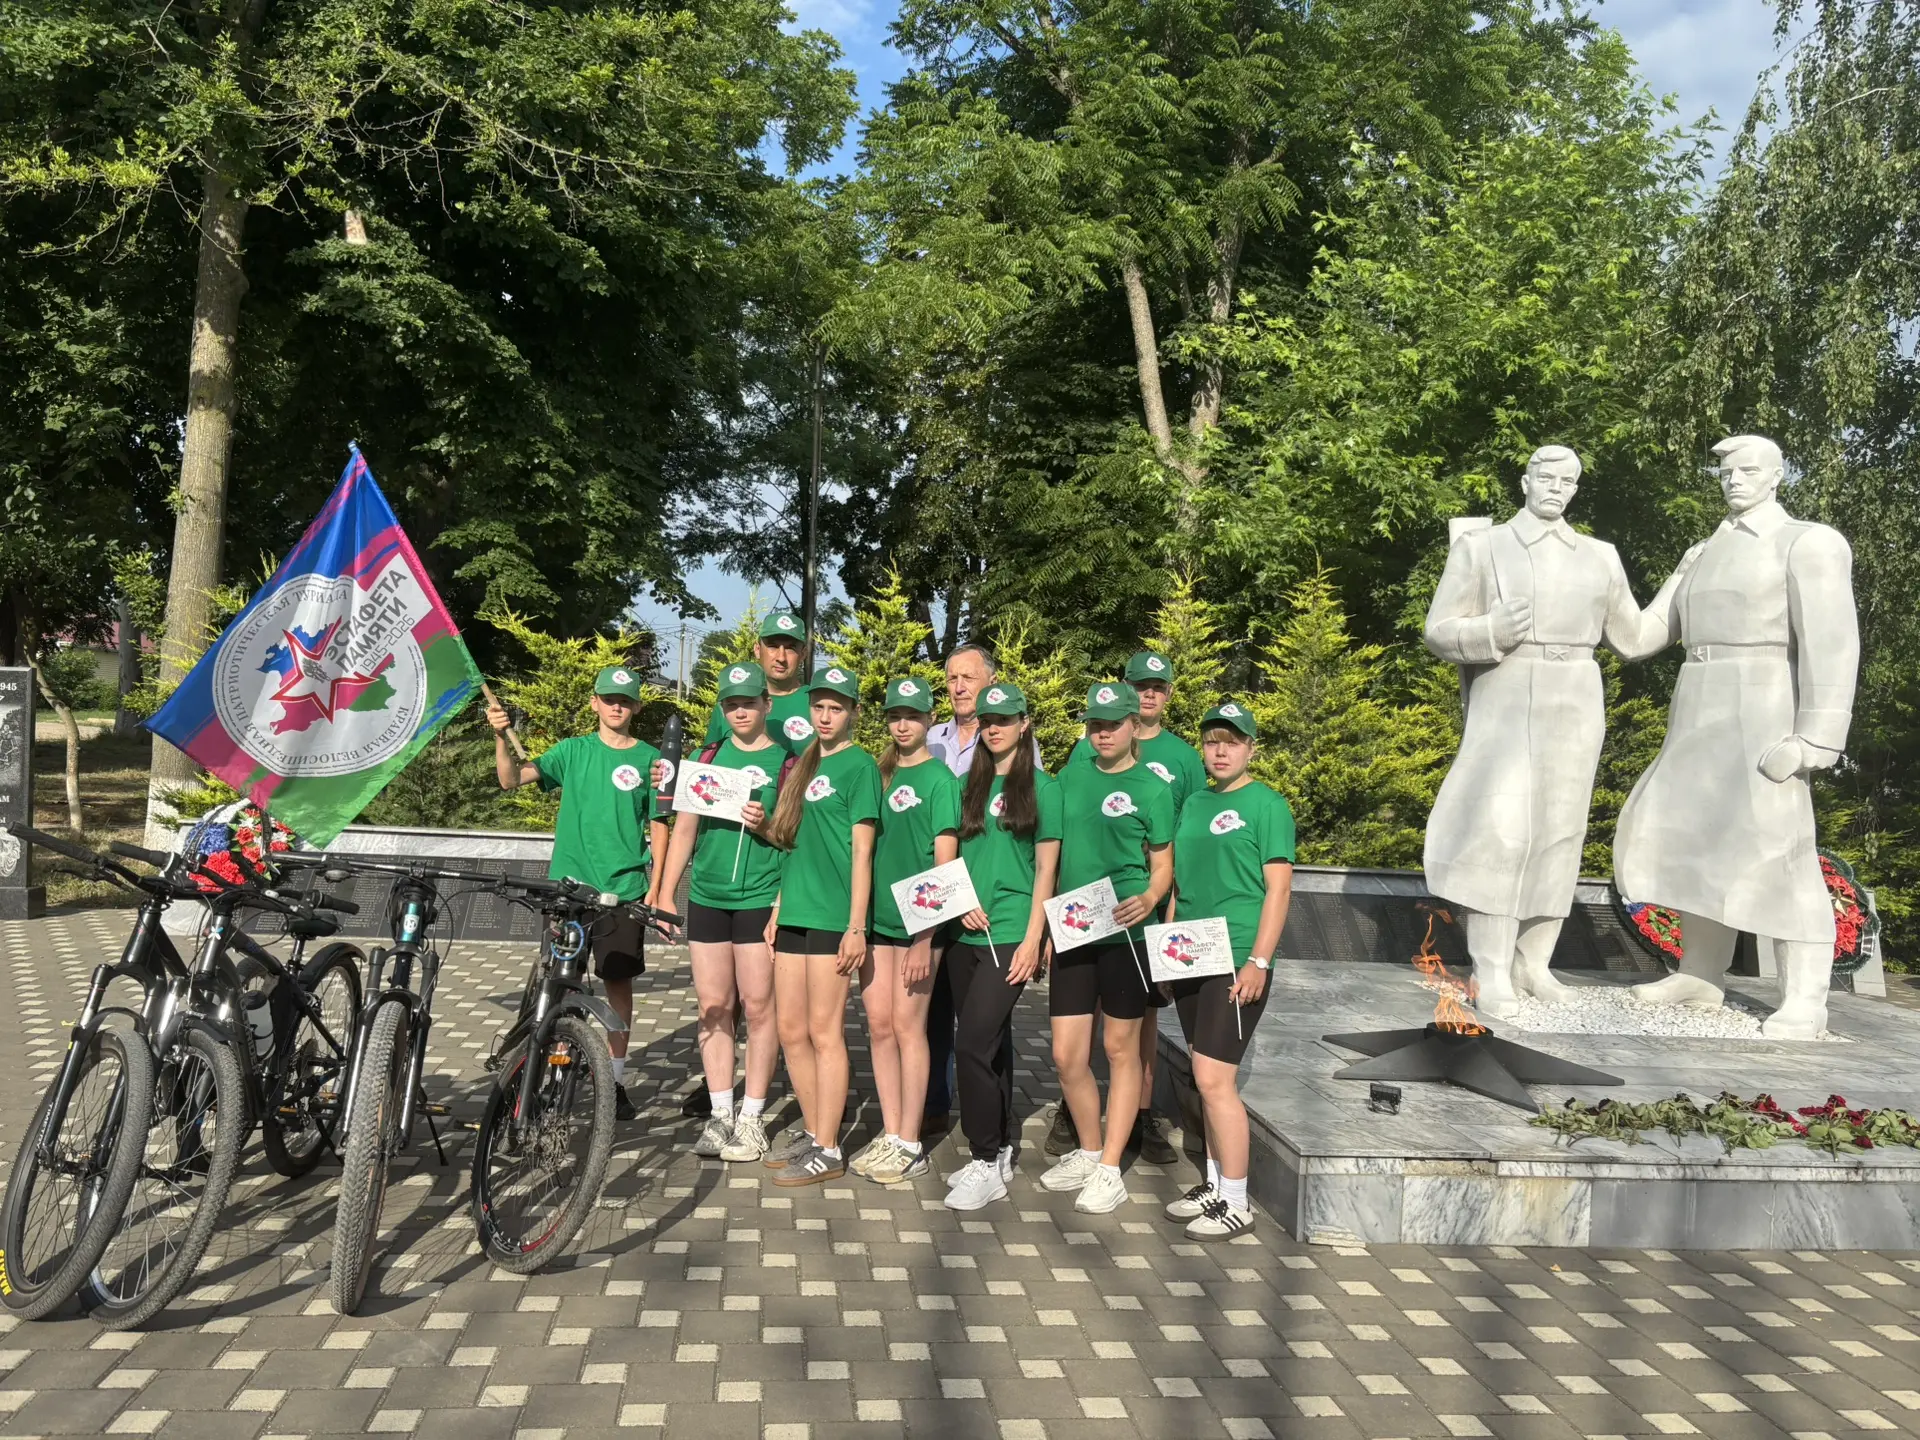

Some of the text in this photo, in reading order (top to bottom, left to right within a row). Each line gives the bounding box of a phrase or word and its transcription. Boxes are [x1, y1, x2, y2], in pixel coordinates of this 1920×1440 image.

[324, 570, 408, 661] ЭСТАФЕТА
[336, 597, 408, 673] ПАМЯТИ
[360, 614, 415, 672] 1945-2026
[229, 589, 409, 765] КРАЕВАЯ ВЕЛОСИПЕДНАЯ ПАТРИОТИЧЕСКАЯ ТУРИАДА
